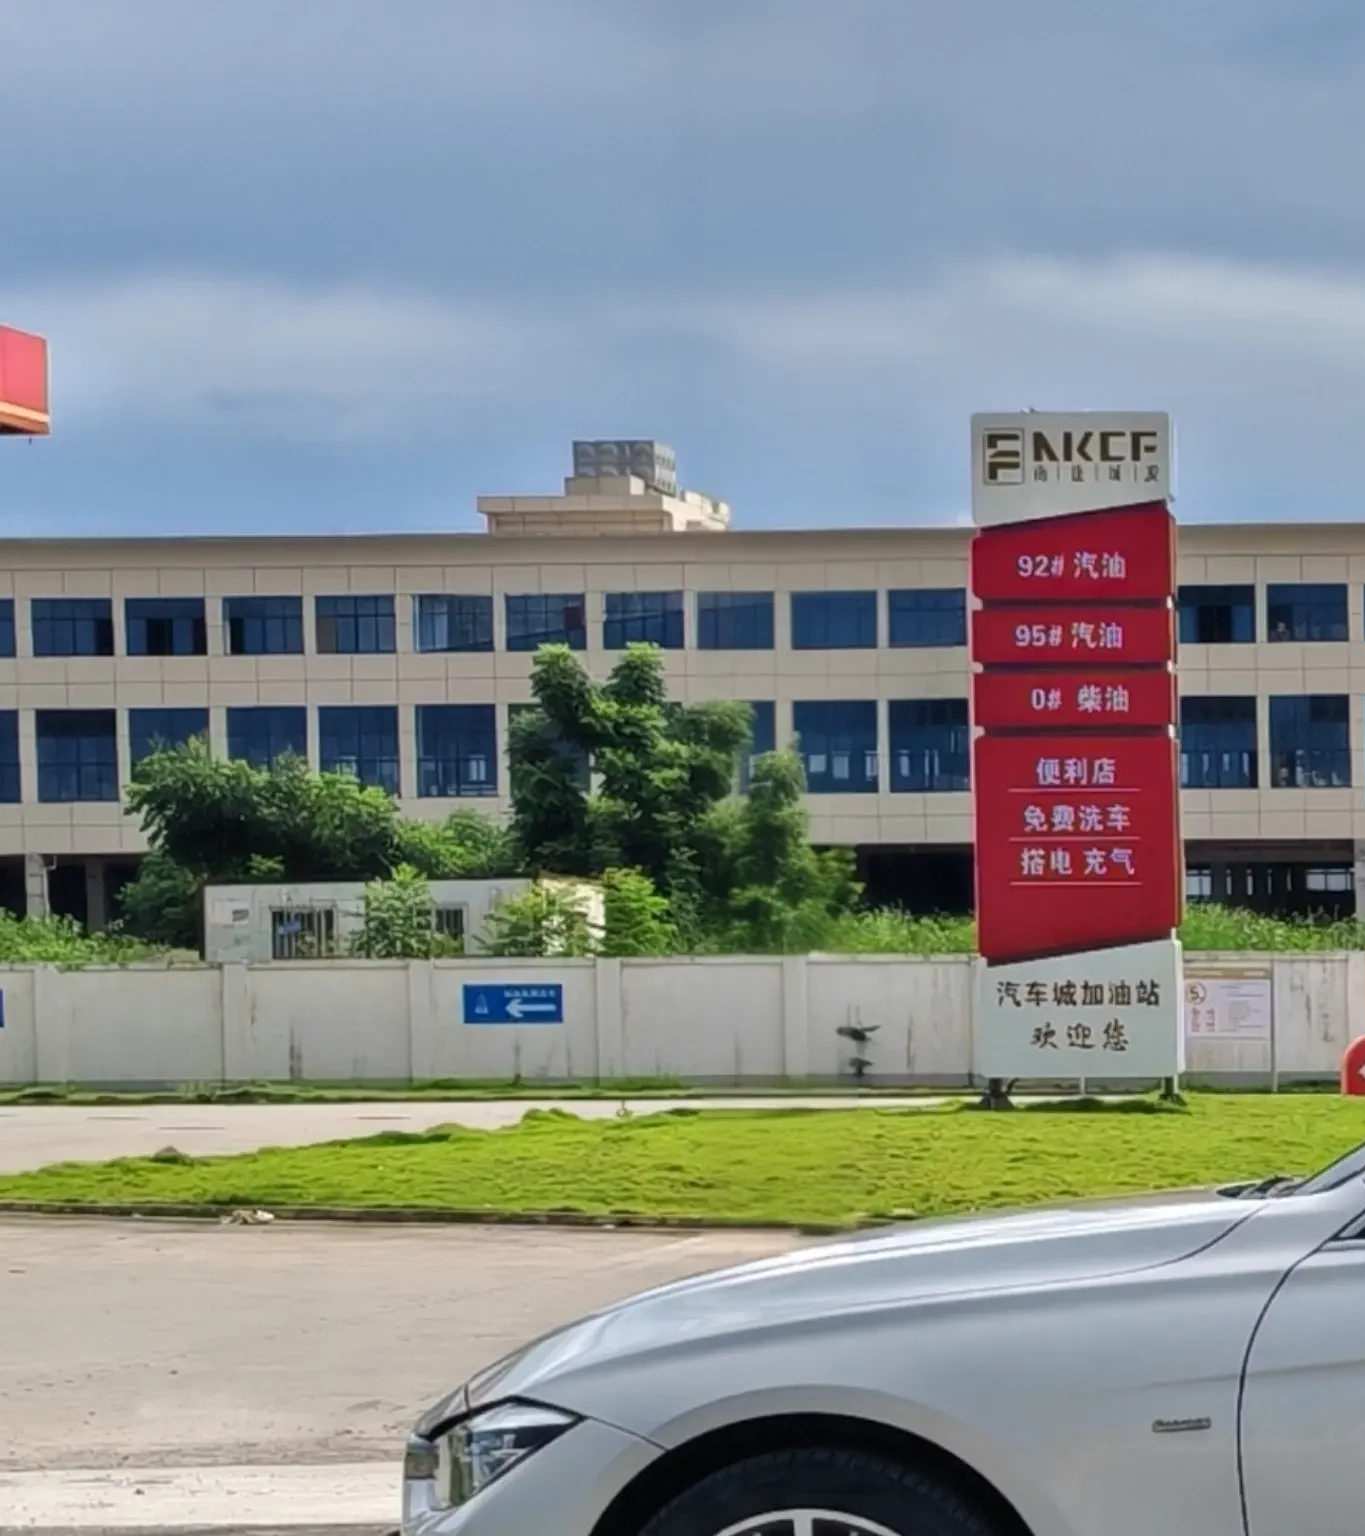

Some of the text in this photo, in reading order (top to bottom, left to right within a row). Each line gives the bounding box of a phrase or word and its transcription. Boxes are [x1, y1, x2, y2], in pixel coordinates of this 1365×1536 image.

[1017, 552, 1127, 579] 92# 汽油
[1015, 622, 1123, 649] 95# 汽油
[1030, 685, 1129, 712] 0# 柴油
[1035, 757, 1117, 786] 便利店
[1023, 805, 1131, 832] 免费洗车
[1021, 848, 1135, 876] 搭电 充气
[997, 979, 1161, 1007] 汽车城加油站
[1030, 1018, 1129, 1052] 欢迎您
